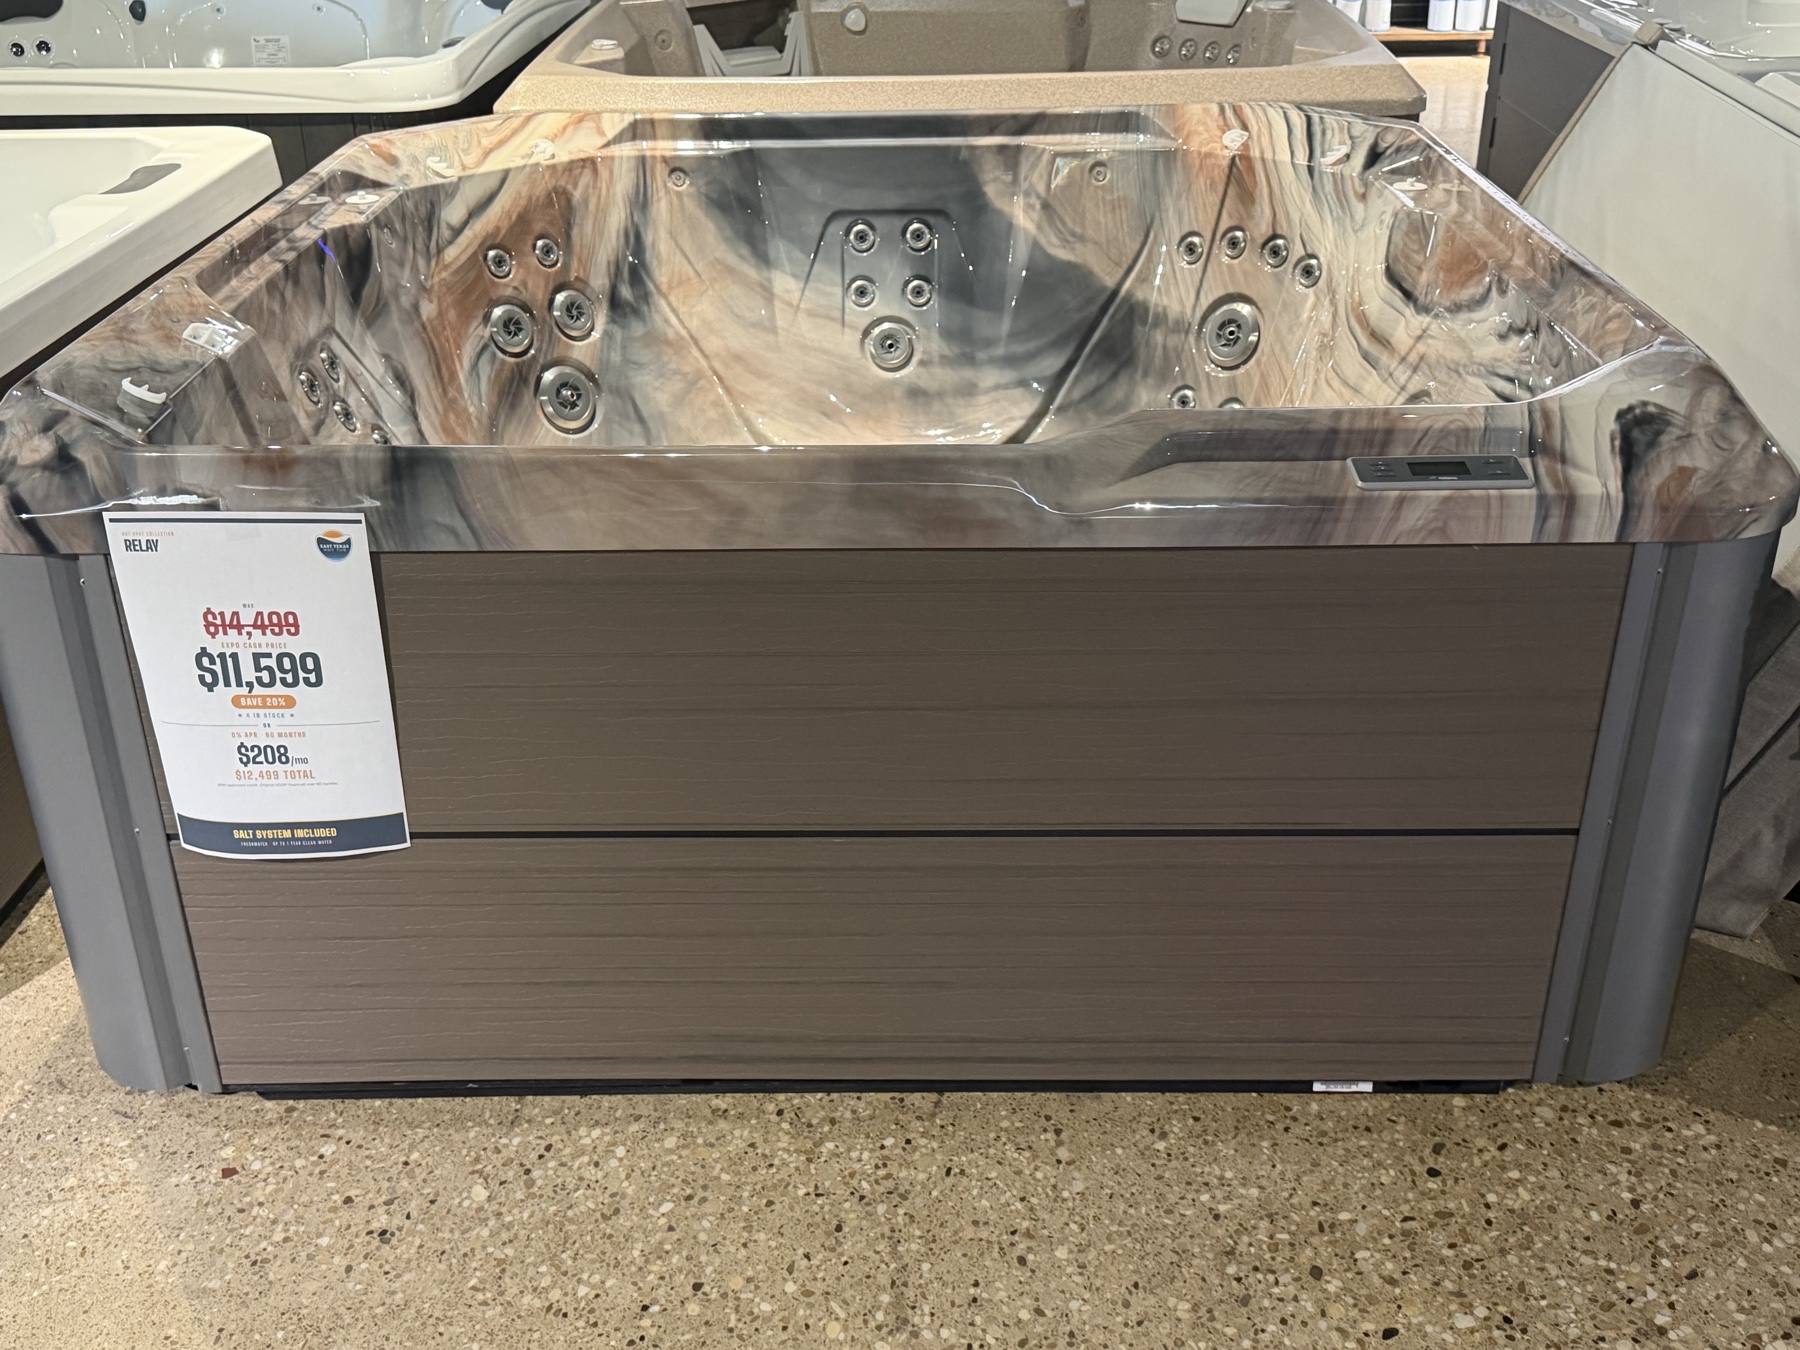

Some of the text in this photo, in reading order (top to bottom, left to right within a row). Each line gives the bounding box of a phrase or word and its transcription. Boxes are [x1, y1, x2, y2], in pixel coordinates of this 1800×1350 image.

[123, 538, 159, 553] RELAY
[202, 607, 300, 640] $14,499
[194, 646, 324, 694] $11,599
[240, 697, 286, 706] SAVE 20%
[244, 731, 258, 739] APR
[235, 769, 316, 781] $12,499 TOTAL
[232, 827, 338, 839] SALT SYSTEM INCLUDED
